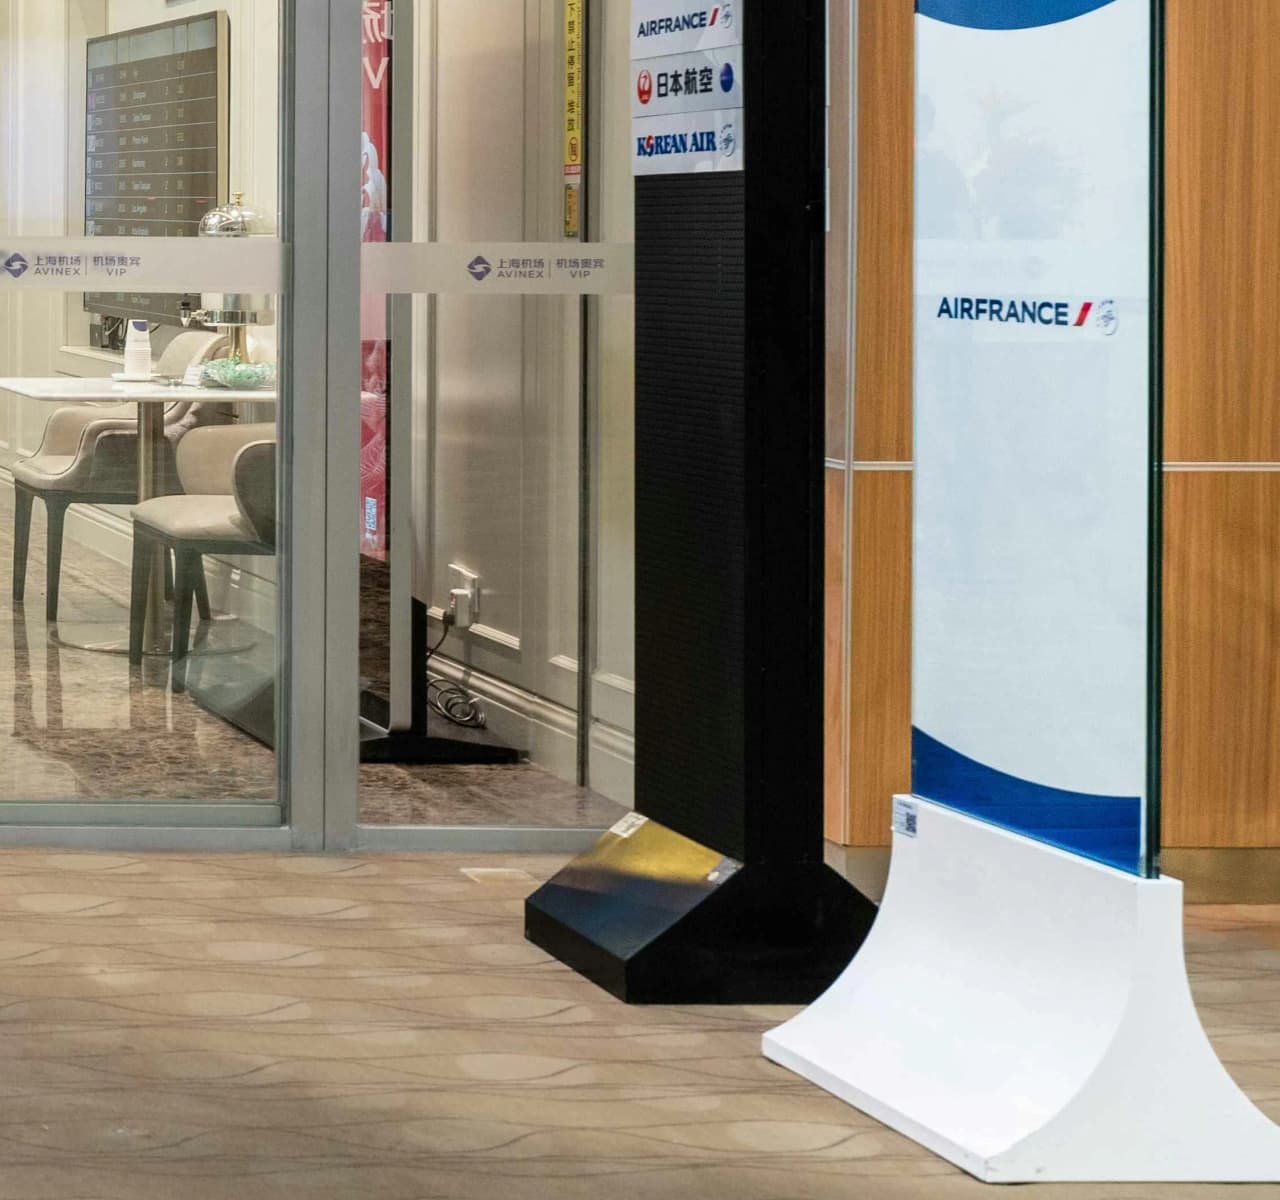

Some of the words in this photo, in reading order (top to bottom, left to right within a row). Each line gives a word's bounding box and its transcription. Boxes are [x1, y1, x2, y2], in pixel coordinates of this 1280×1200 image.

[637, 11, 707, 38] AIRFRANCE
[657, 66, 713, 98] 日本航空
[637, 133, 688, 156] KOREAN
[689, 131, 716, 152] AIR
[34, 255, 81, 266] 上海机场
[496, 258, 544, 269] 上海机场
[34, 268, 80, 276] AVINEX
[106, 268, 127, 276] VIP
[497, 270, 544, 278] AVINEX
[570, 270, 591, 278] VIP
[937, 296, 1068, 326] AIRFRANCE
